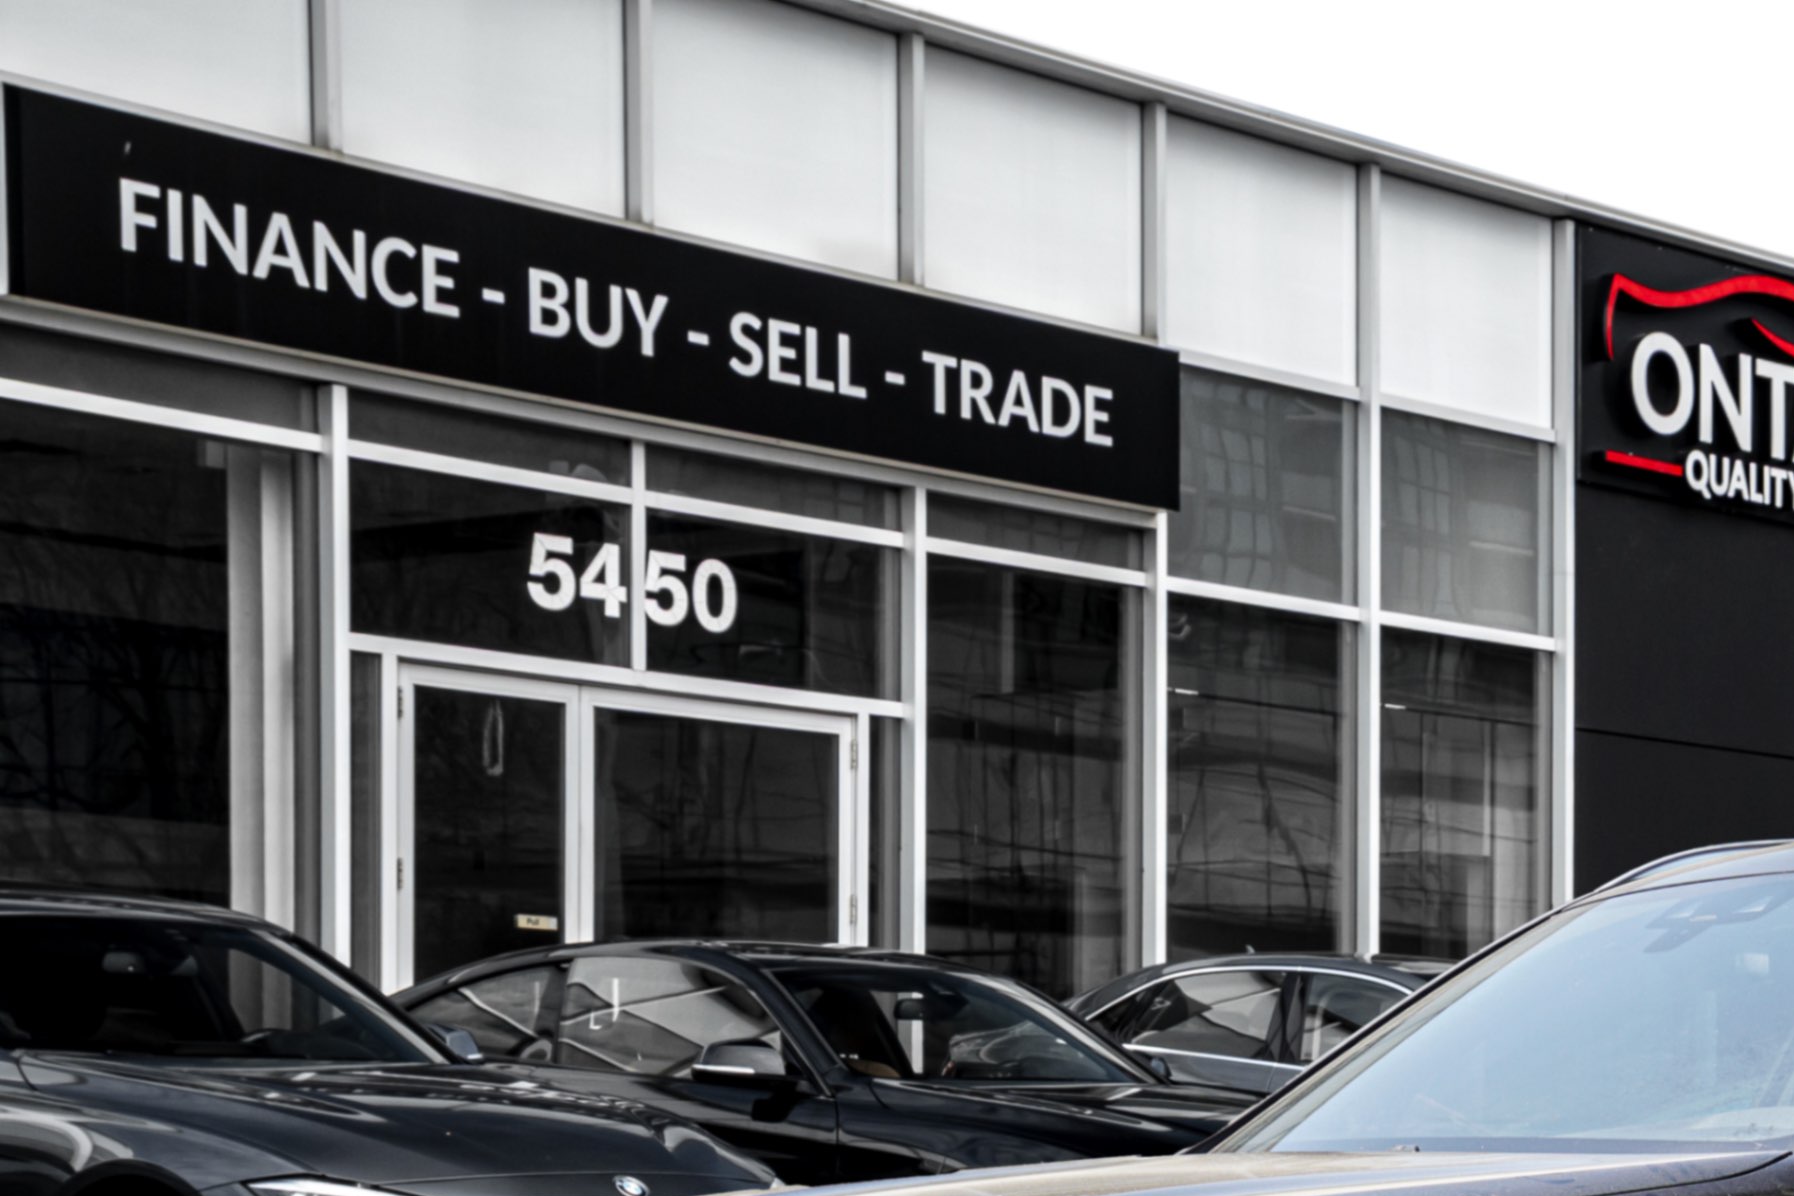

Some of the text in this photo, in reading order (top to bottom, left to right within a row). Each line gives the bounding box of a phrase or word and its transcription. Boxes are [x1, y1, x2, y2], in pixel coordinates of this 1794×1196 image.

[119, 178, 461, 318] FINANCE
[528, 267, 669, 358] BUY
[729, 312, 867, 399] SELL
[922, 350, 1113, 447] TRADE
[527, 532, 737, 634] 5450
